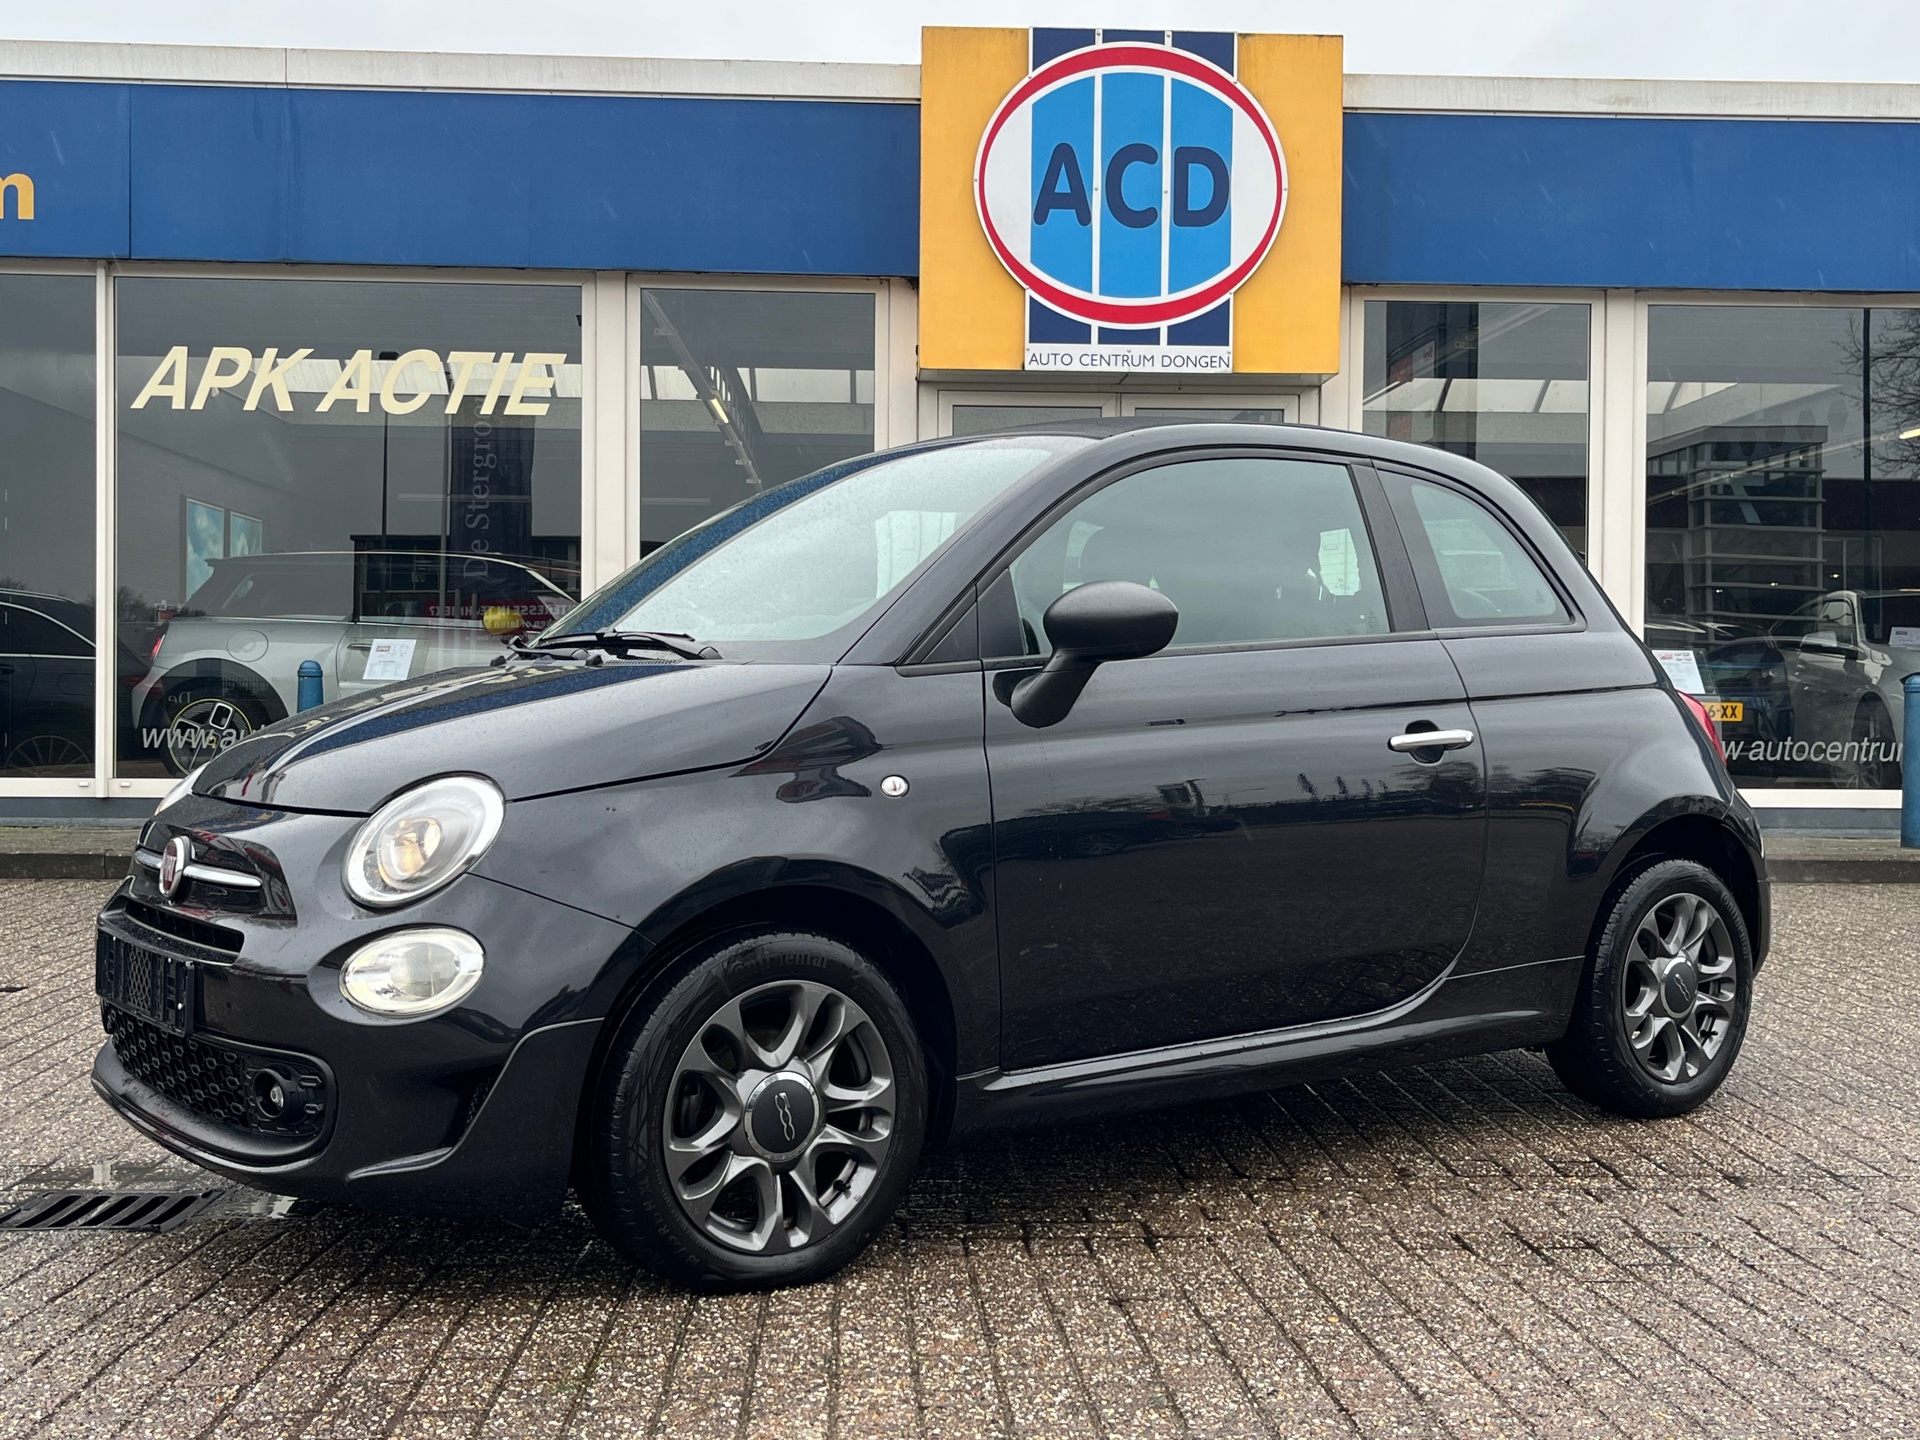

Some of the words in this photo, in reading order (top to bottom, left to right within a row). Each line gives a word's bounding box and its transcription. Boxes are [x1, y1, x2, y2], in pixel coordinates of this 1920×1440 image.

[1033, 142, 1230, 229] ACD
[130, 345, 315, 412] APK
[315, 348, 568, 416] ACTIE
[1029, 353, 1073, 366] AUTO
[1079, 353, 1155, 368] CENTRUM
[1160, 354, 1230, 369] DONGEN
